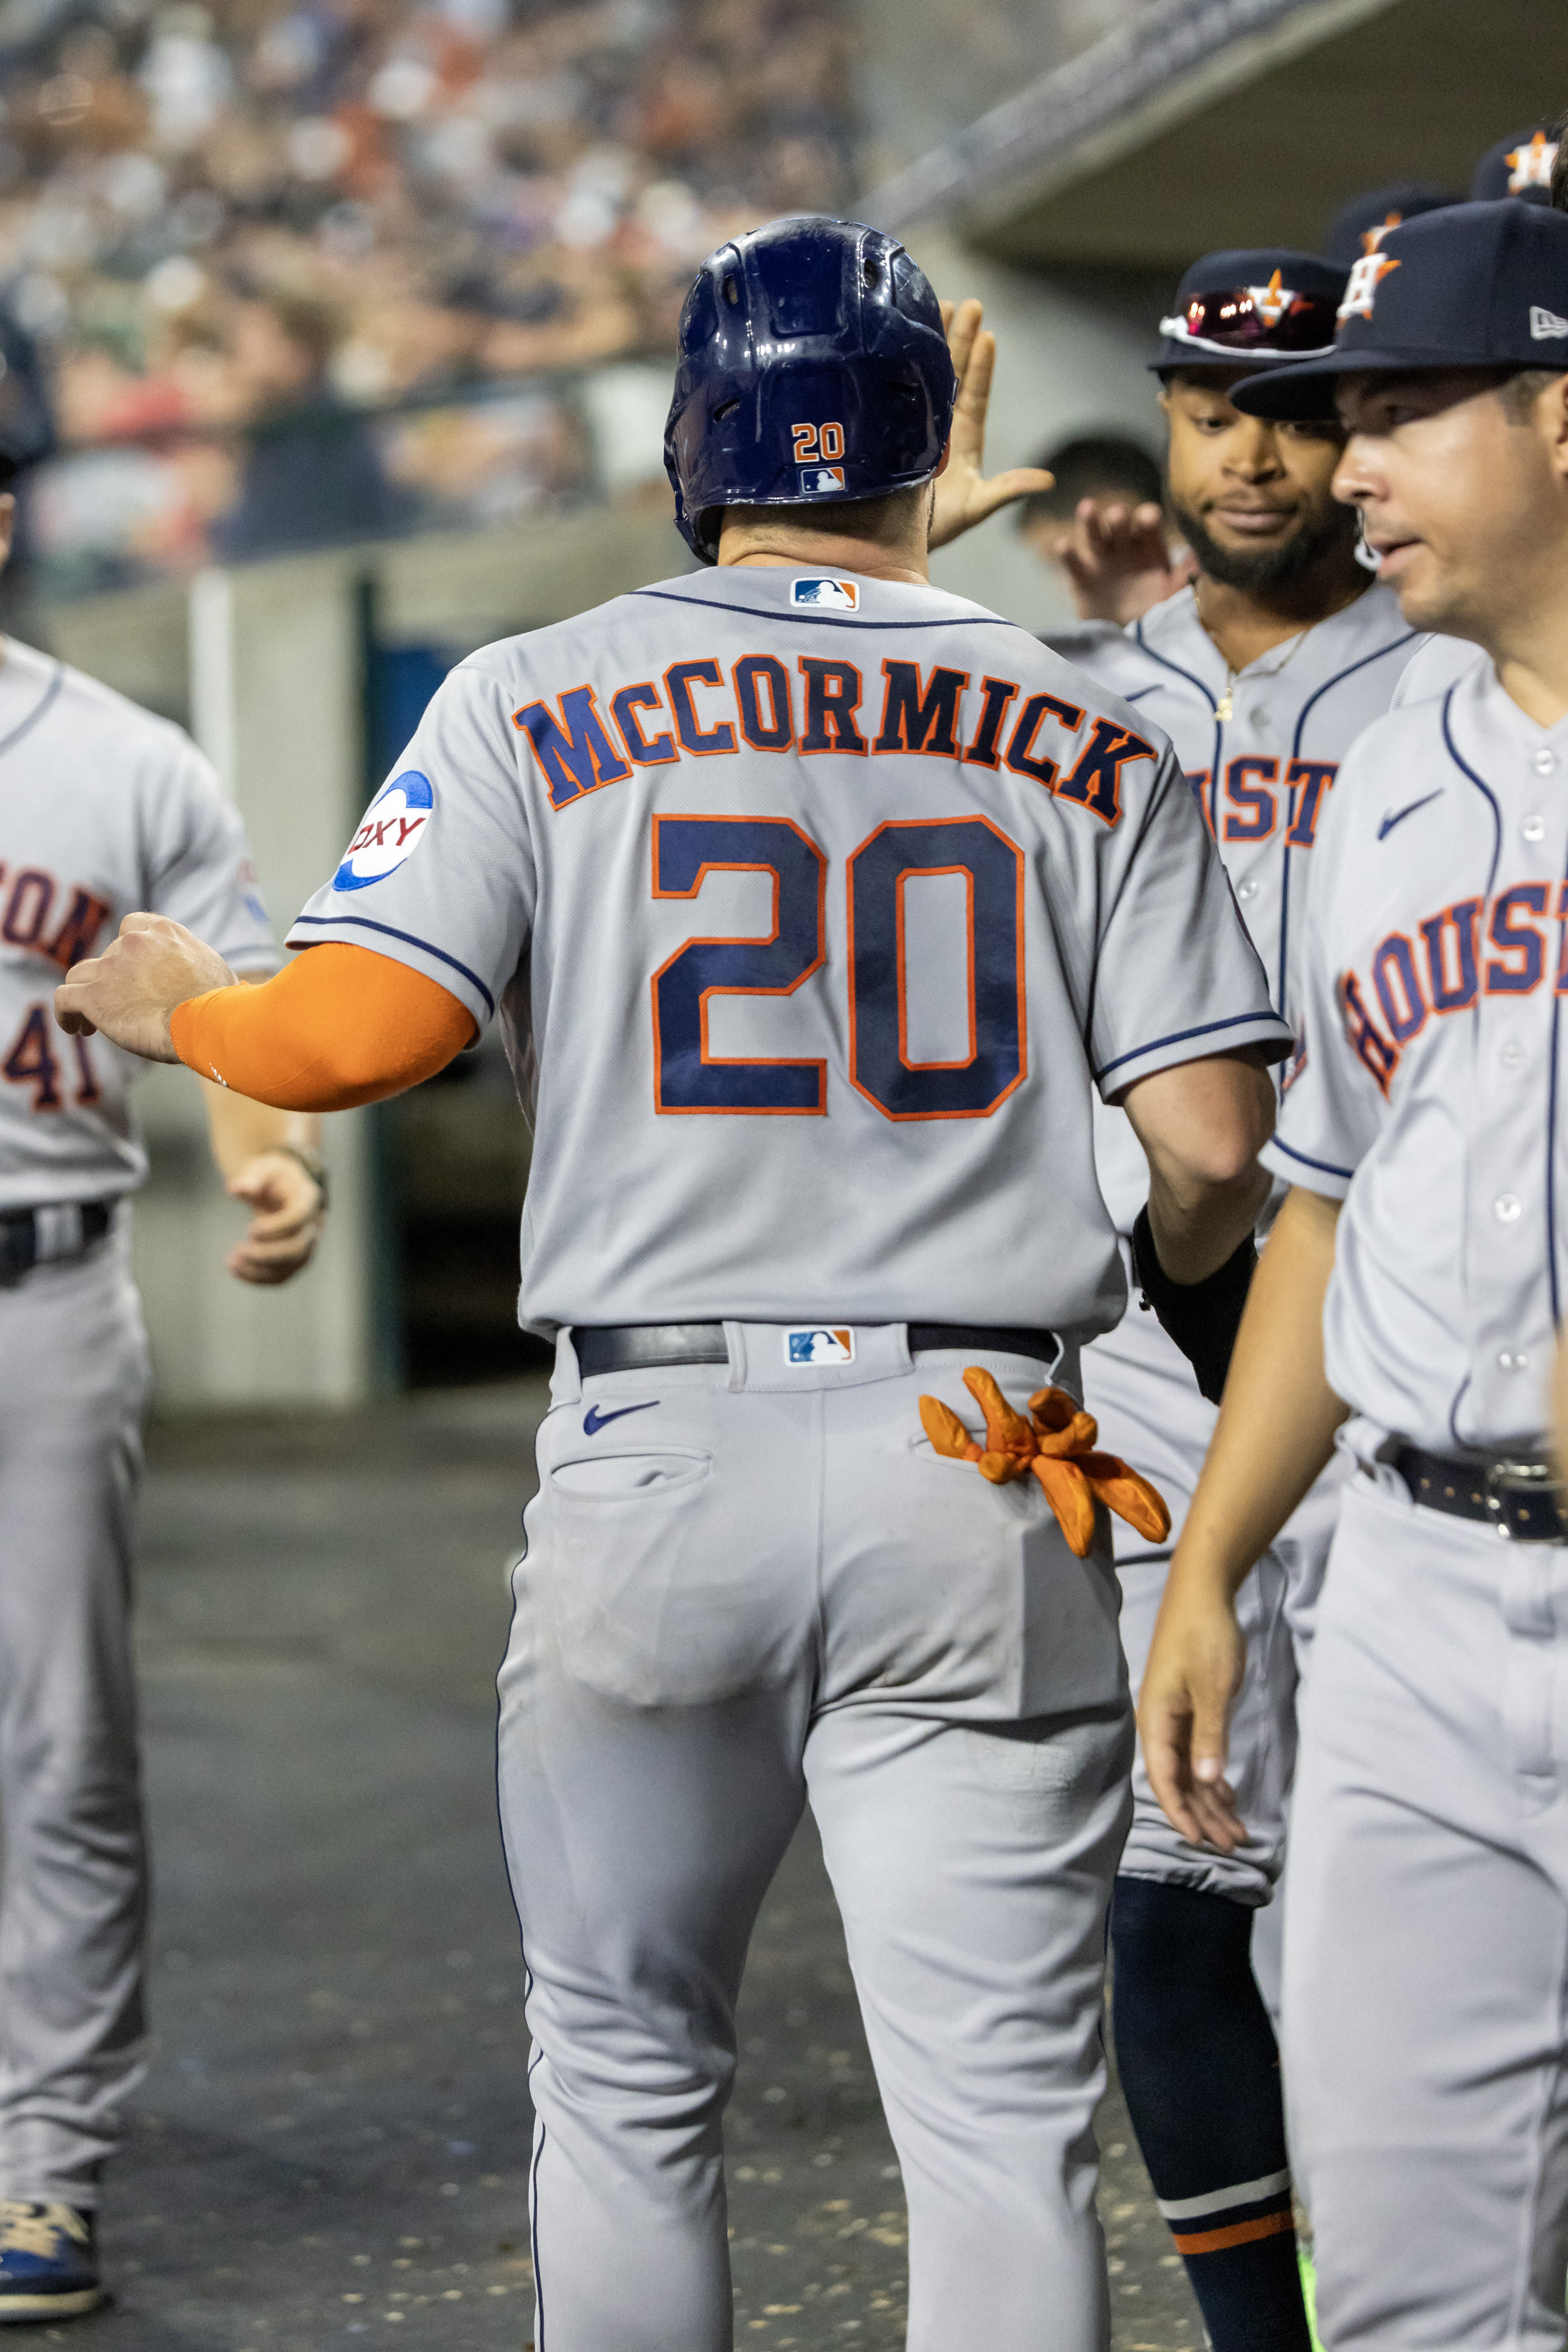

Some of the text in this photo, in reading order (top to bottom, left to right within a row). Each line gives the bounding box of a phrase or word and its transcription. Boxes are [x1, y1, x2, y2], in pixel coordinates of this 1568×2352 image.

[791, 422, 845, 463] 20
[347, 817, 427, 855] OXY
[0, 860, 111, 968] ON
[651, 813, 1027, 1122] 20
[1338, 879, 1568, 1104] HOUS
